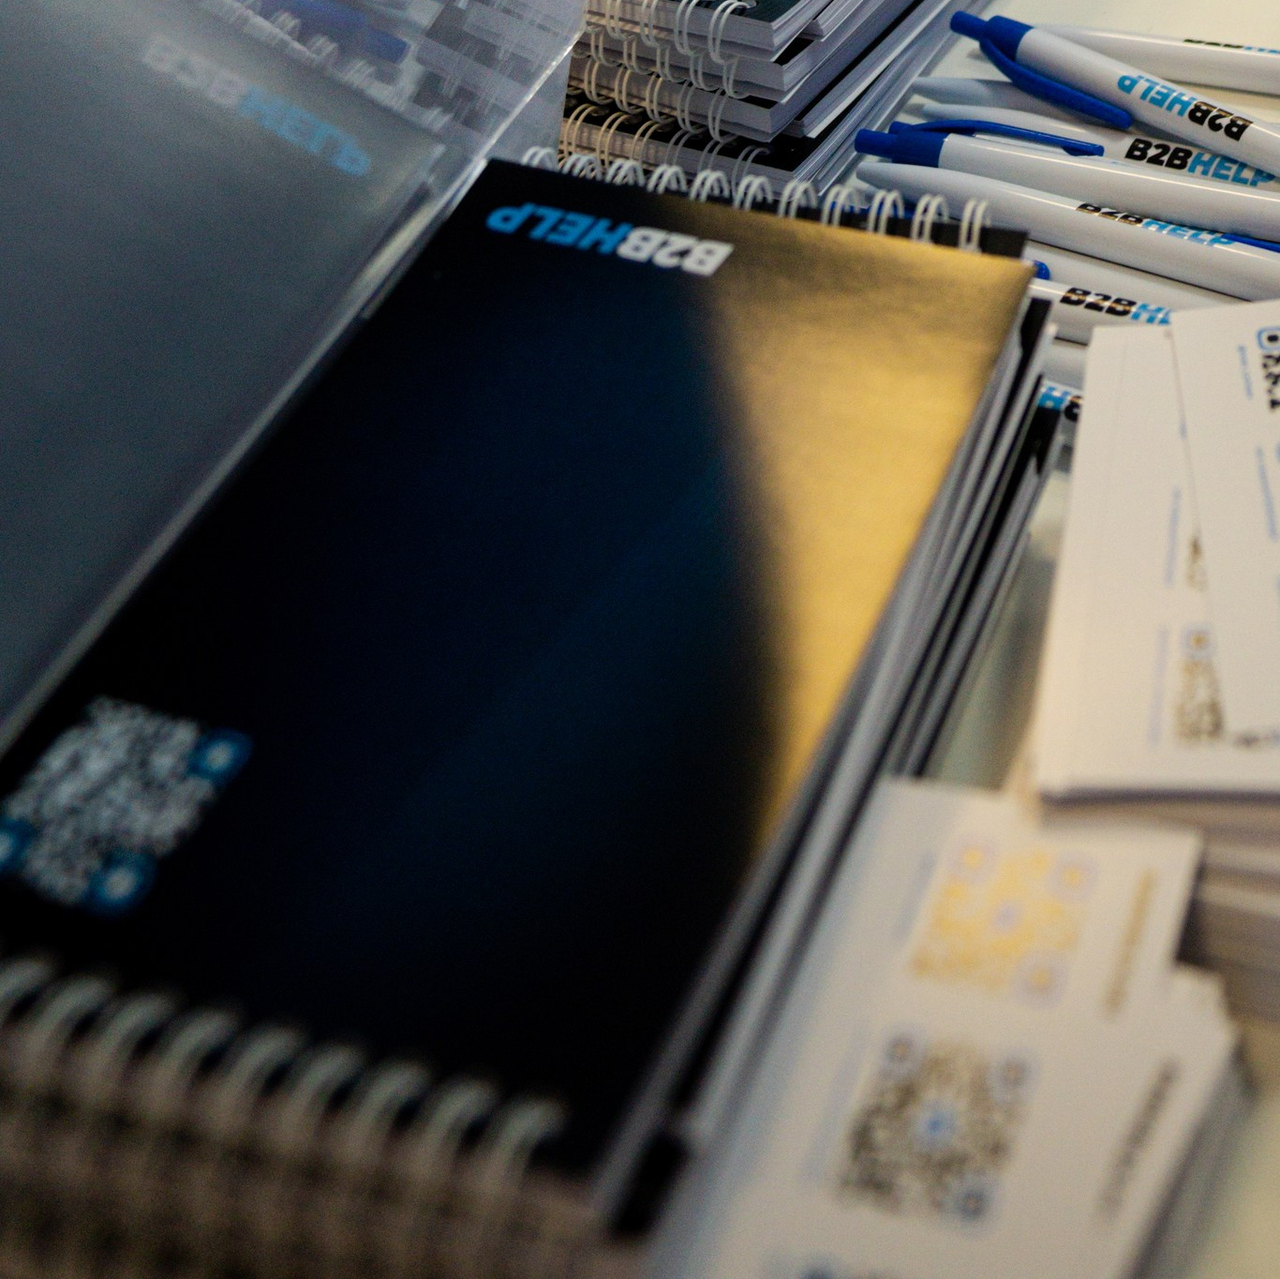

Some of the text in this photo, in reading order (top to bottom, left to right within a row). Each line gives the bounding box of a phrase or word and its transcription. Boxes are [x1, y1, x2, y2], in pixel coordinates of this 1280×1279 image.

[1117, 74, 1254, 142] B2BHELP
[1125, 138, 1276, 187] B2BHELP
[485, 202, 735, 277] B2BHELP
